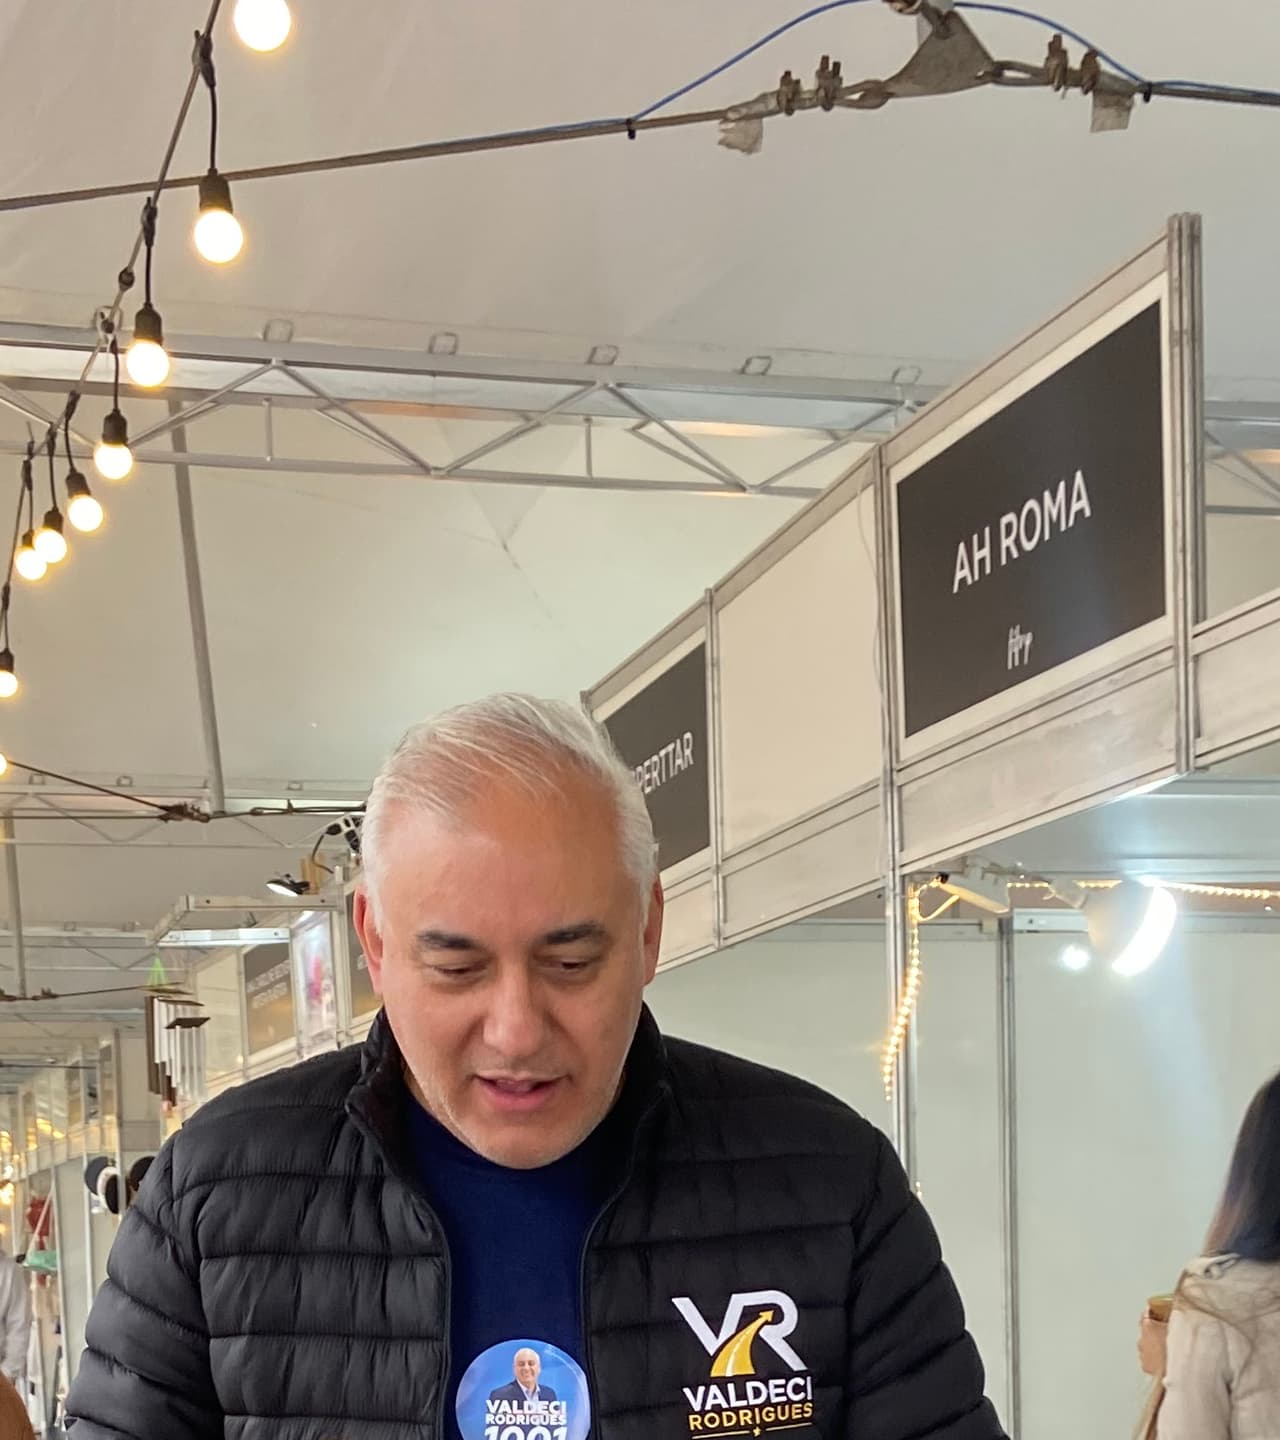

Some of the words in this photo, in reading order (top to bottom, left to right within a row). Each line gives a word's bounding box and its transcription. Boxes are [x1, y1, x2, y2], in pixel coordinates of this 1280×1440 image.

[952, 526, 992, 594] AH
[1000, 469, 1091, 566] ROMA
[671, 1289, 809, 1372] VR
[485, 1399, 567, 1416] VALDECI
[682, 1376, 813, 1412] VALDECI
[485, 1413, 567, 1427] RODRIGUES
[688, 1402, 814, 1431] RODRIGUES
